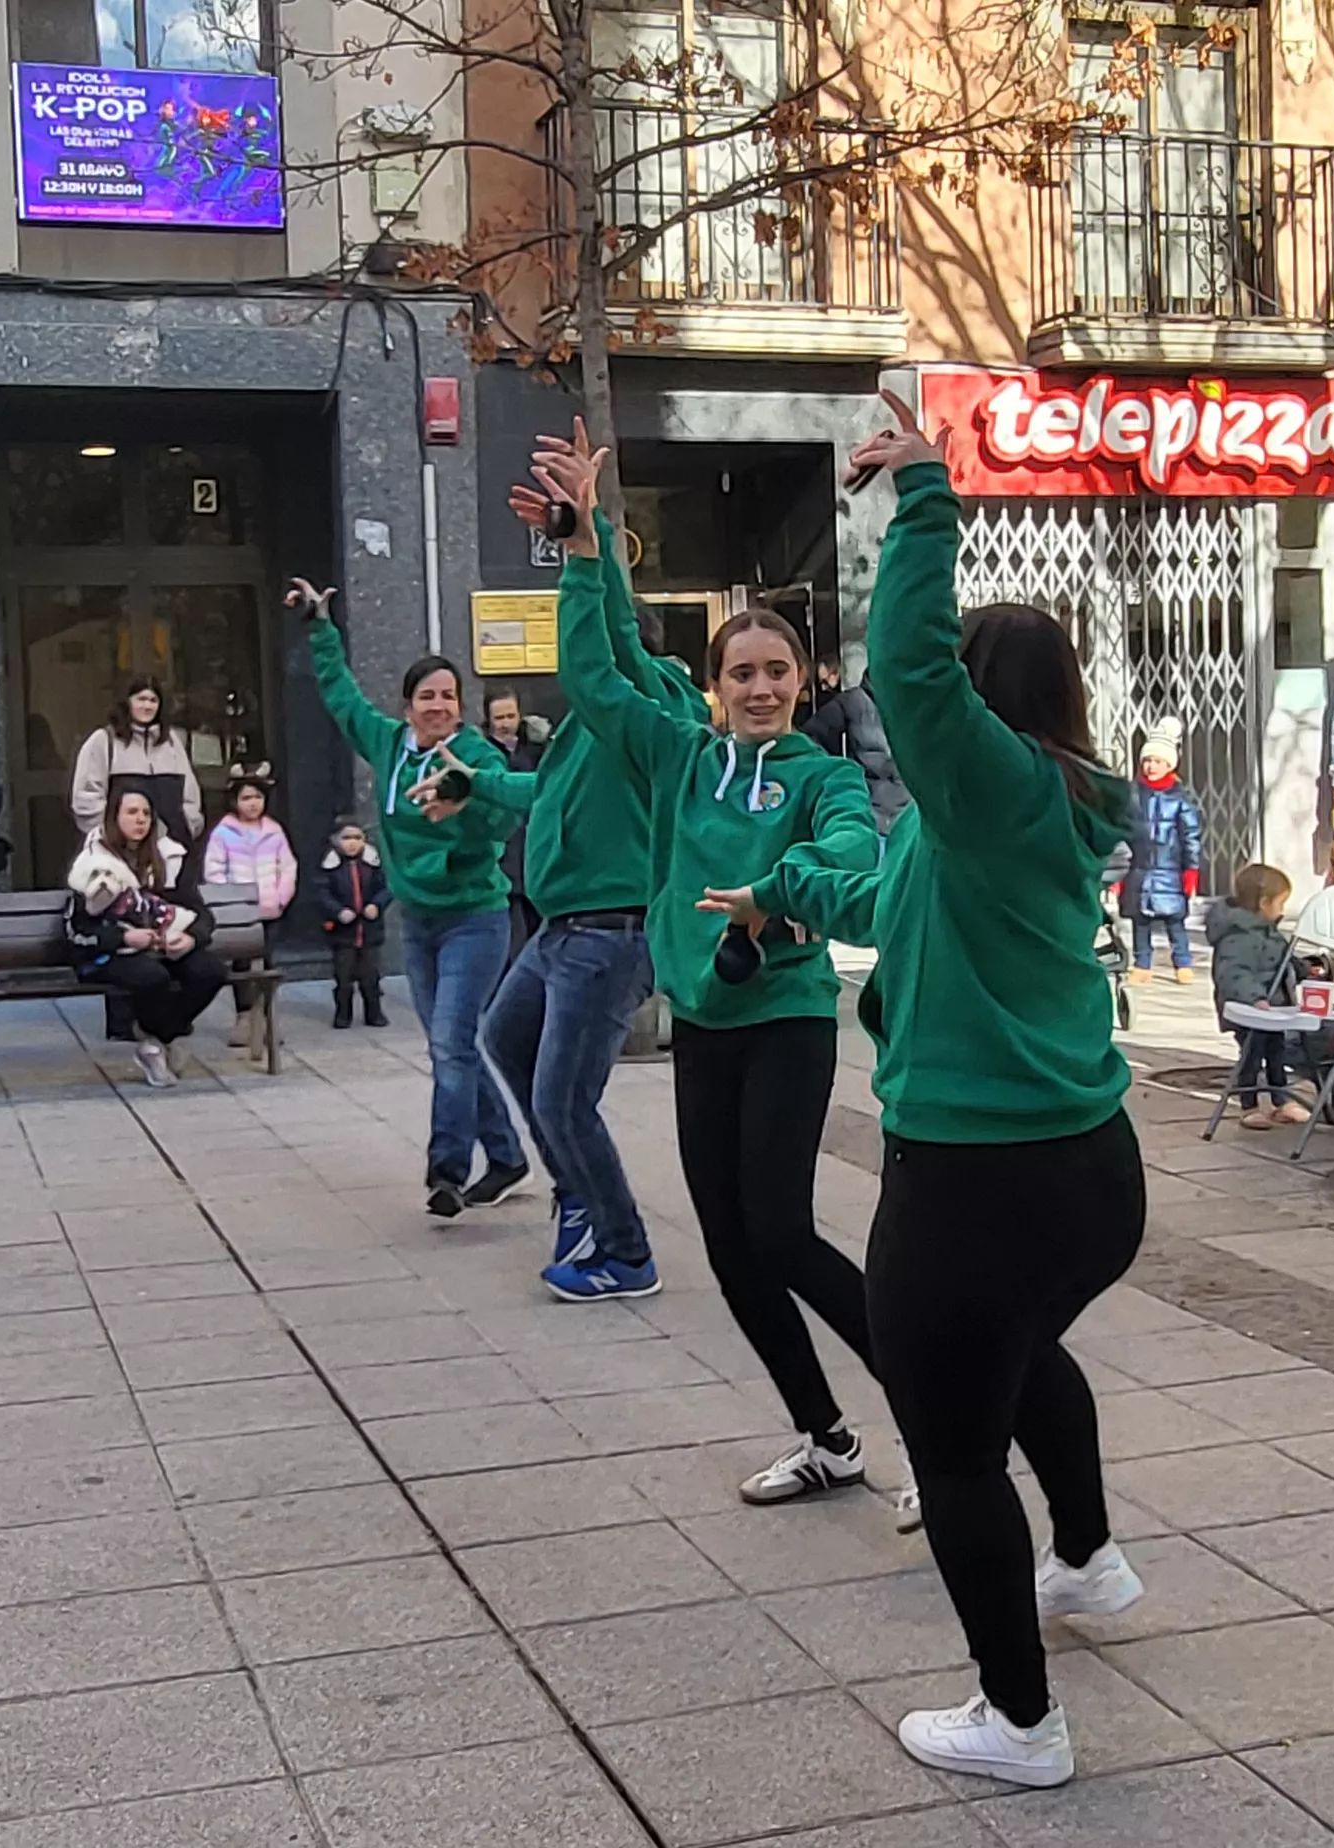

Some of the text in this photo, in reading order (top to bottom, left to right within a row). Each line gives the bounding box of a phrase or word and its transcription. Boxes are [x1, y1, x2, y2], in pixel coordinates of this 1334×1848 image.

[31, 82, 52, 94] LA
[31, 95, 147, 123] K-POP
[58, 162, 76, 176] 31
[197, 482, 214, 509] 2
